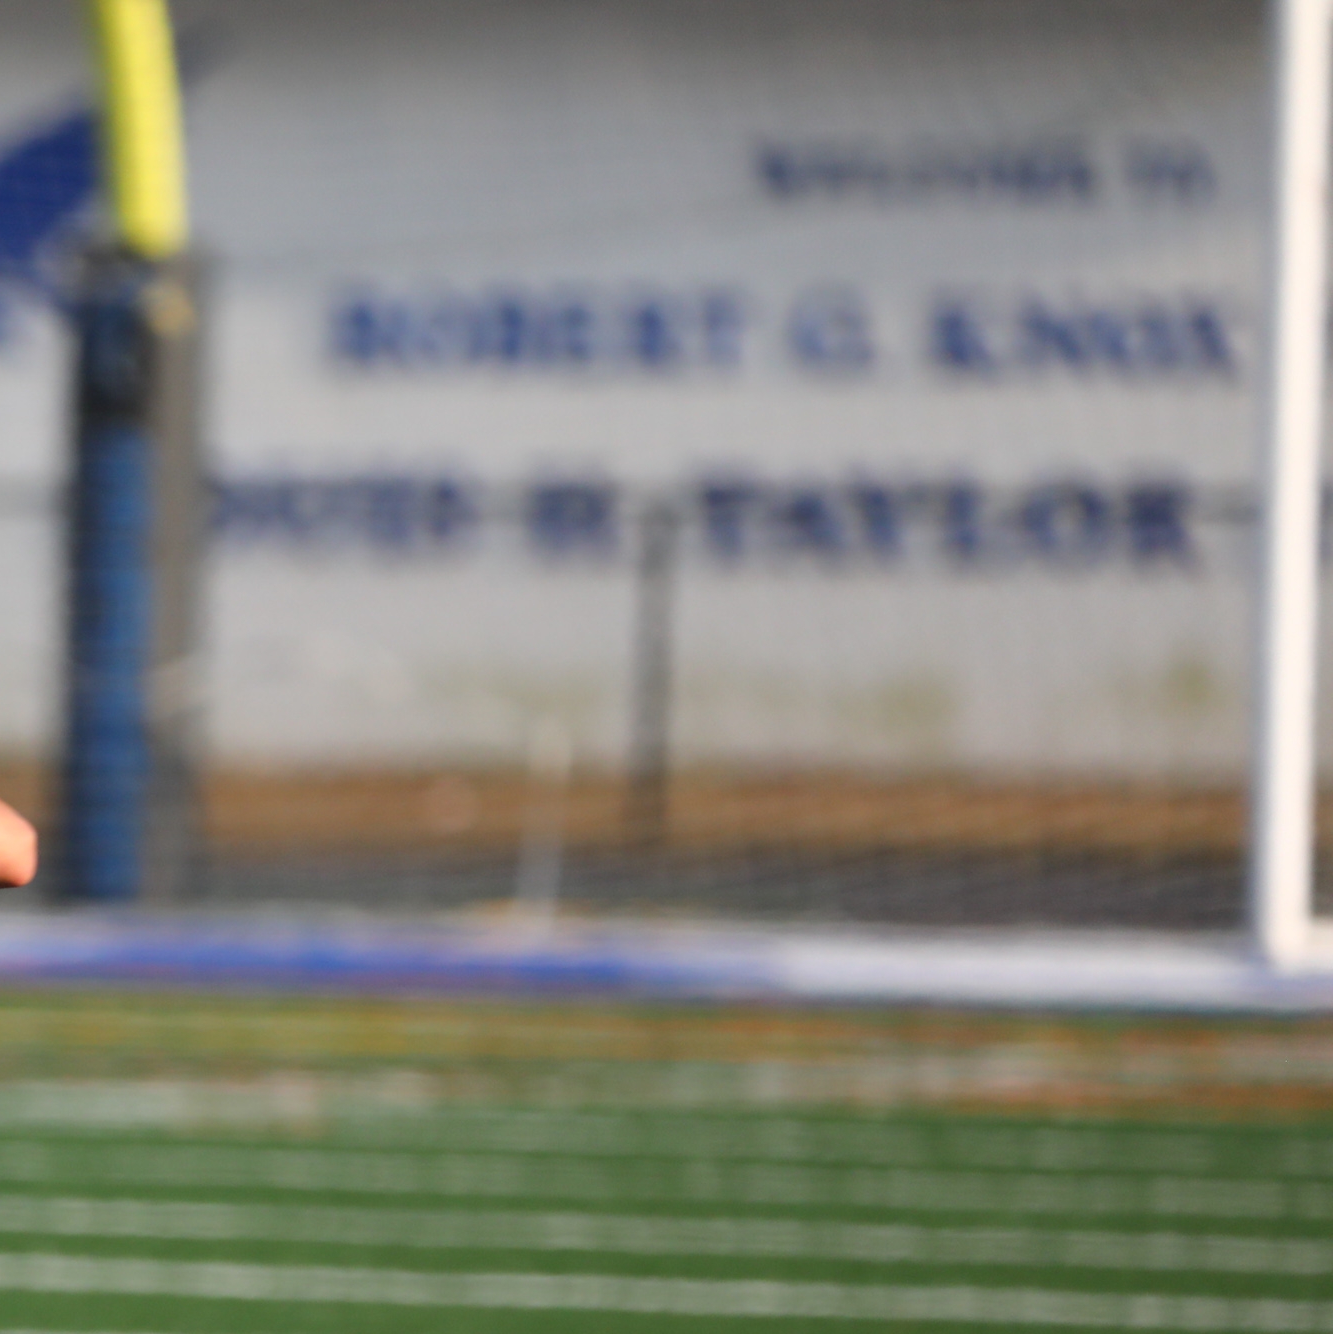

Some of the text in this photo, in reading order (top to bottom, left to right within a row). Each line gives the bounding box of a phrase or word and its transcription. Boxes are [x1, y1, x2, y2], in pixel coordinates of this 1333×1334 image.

[333, 284, 745, 373] ROBERT
[930, 284, 1239, 378] KNOX
[700, 468, 1201, 567] TAYLOR
